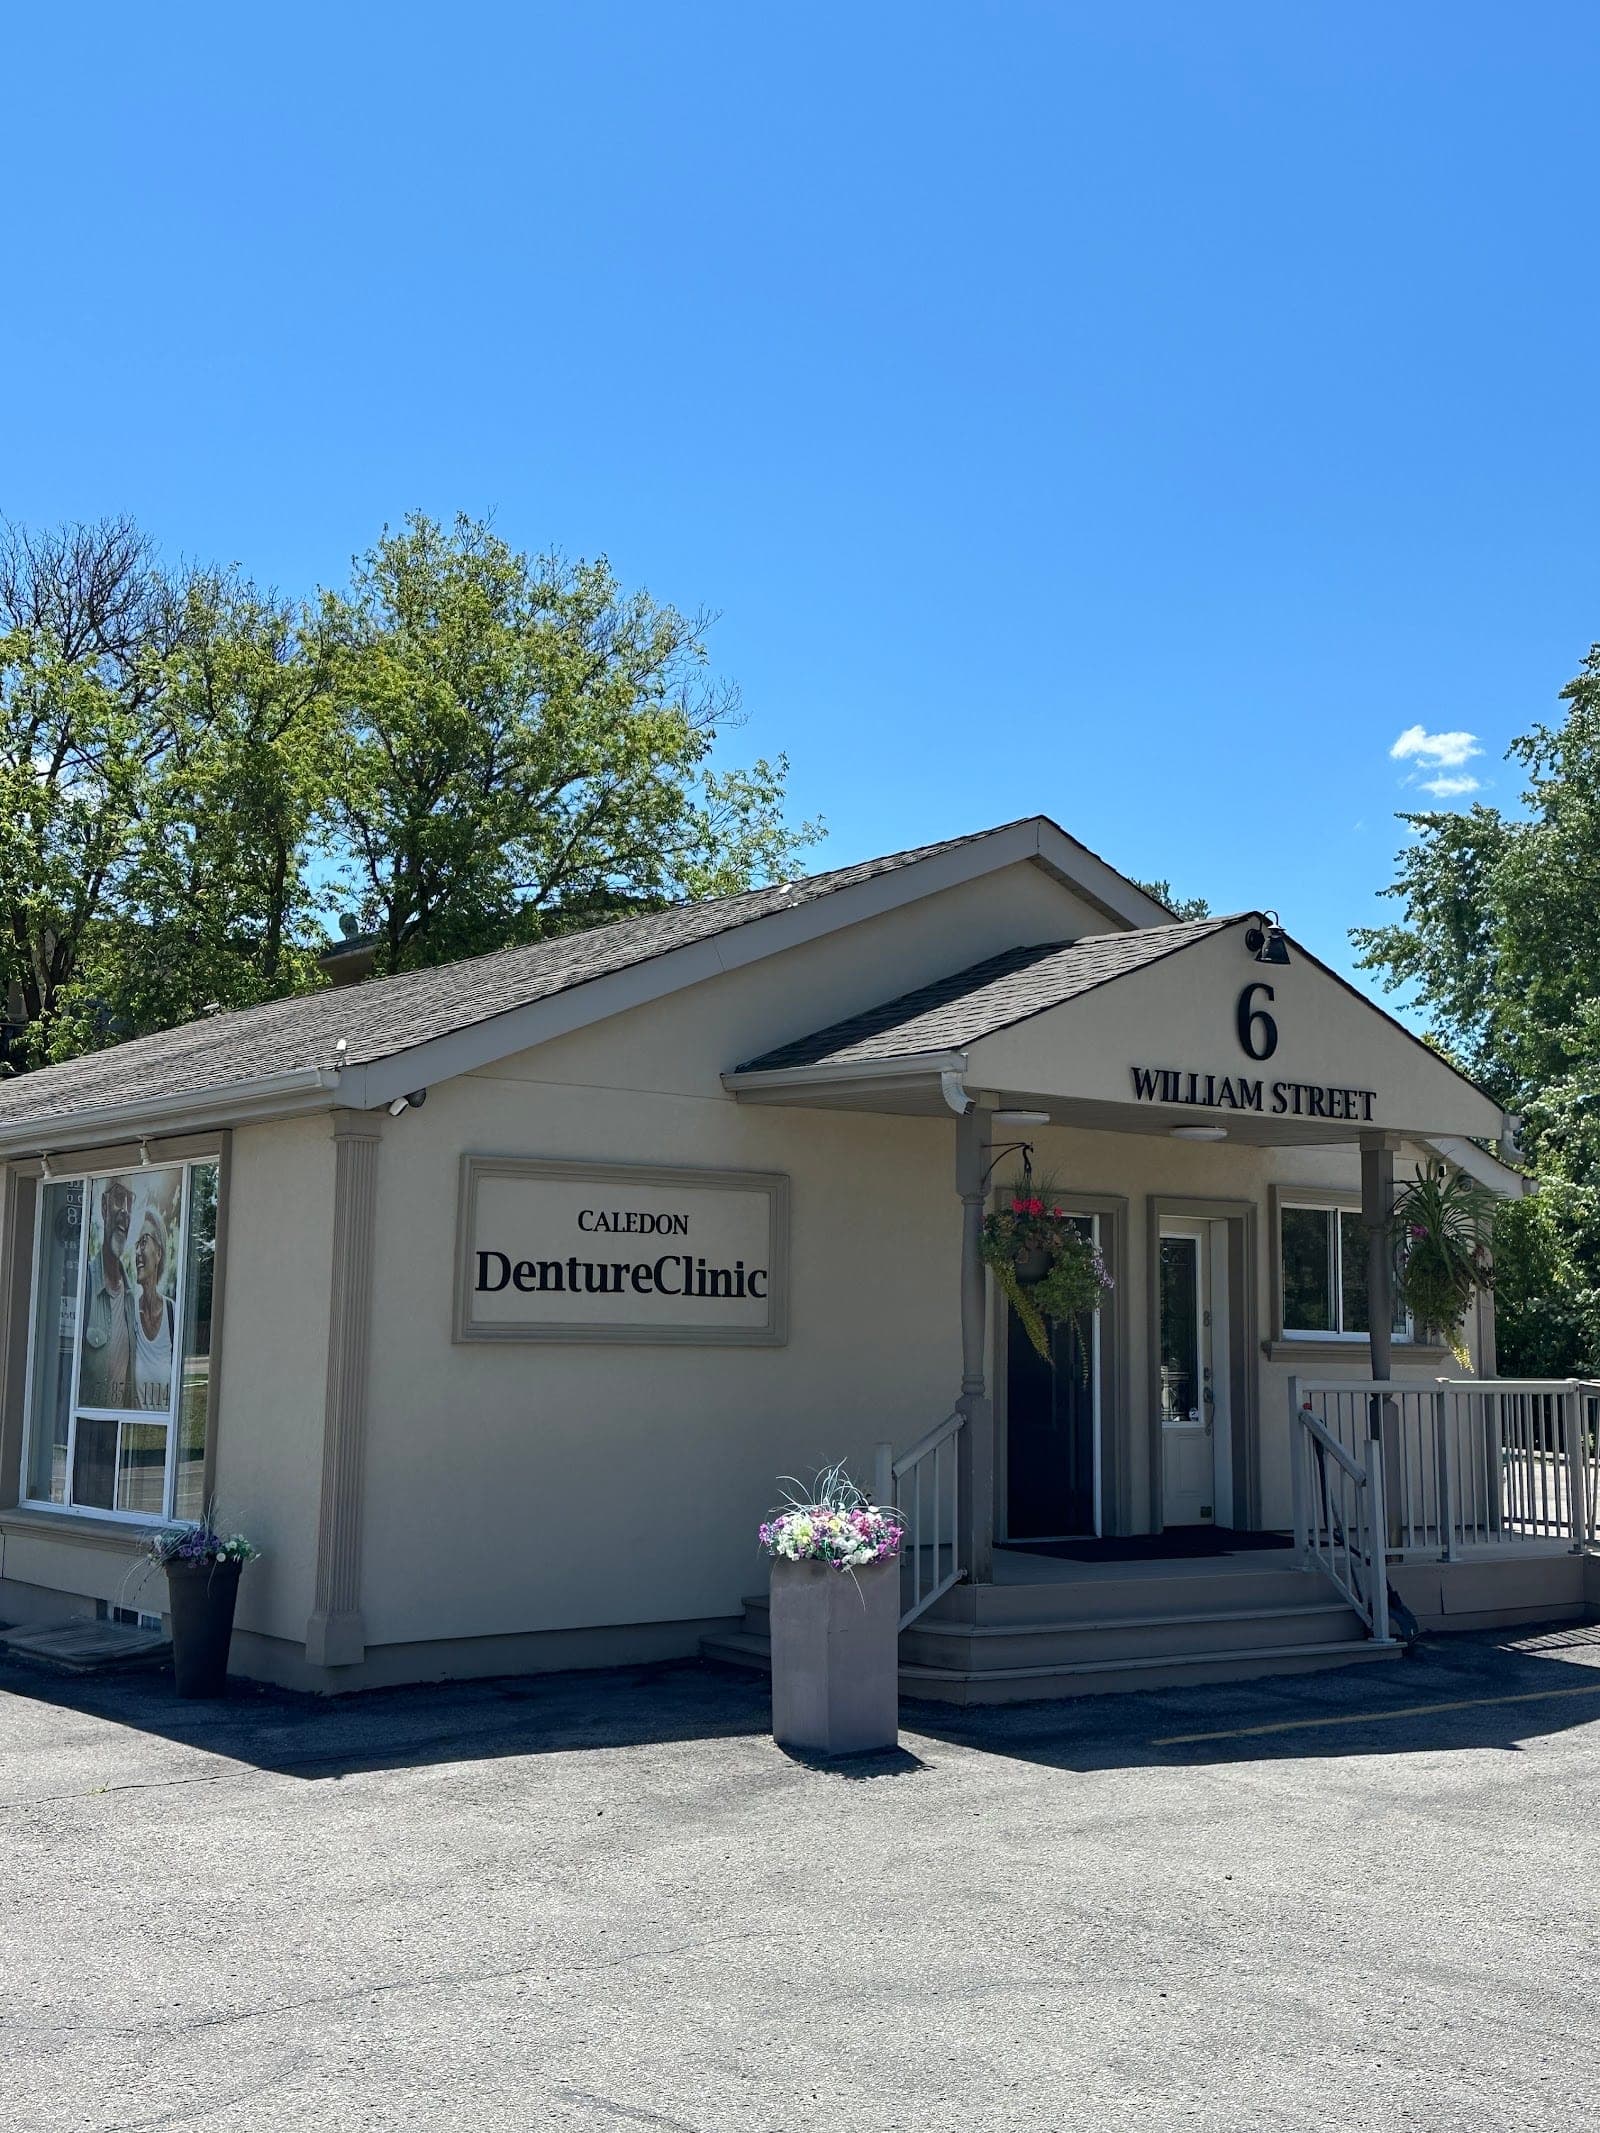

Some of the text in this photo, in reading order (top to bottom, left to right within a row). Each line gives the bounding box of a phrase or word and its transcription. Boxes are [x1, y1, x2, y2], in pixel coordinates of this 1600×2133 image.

[1237, 982, 1278, 1061] 6
[1131, 1066, 1377, 1122] WILLIAM STREET
[577, 1210, 689, 1235] CALEDON
